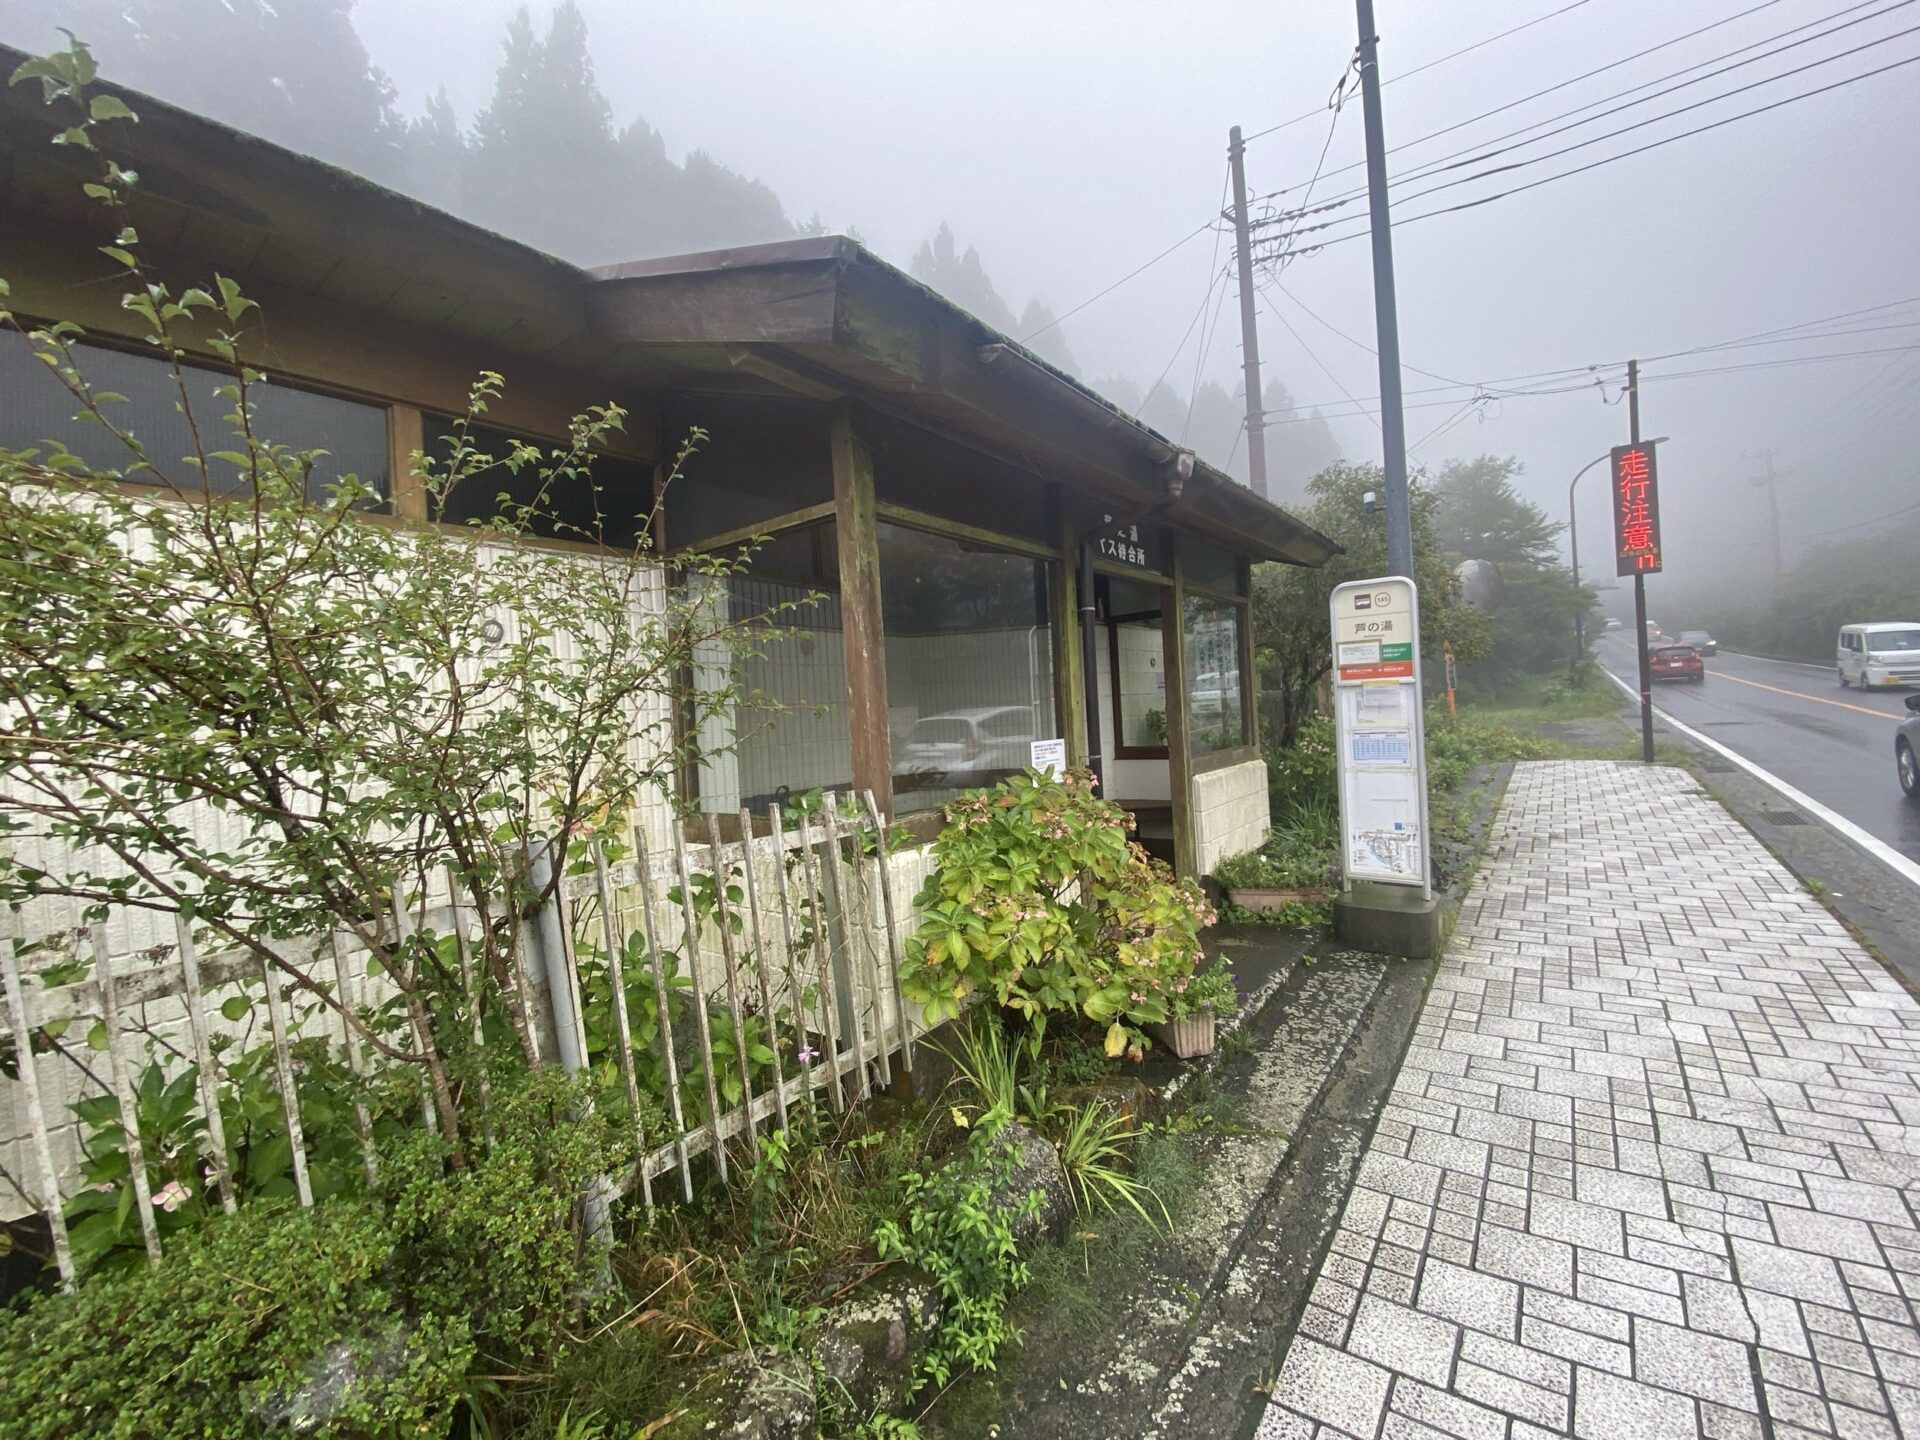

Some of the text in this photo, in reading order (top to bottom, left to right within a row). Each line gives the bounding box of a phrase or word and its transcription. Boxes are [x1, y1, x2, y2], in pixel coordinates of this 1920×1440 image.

[1619, 449, 1653, 551] 走行注意
[1638, 554, 1653, 569] 17
[1355, 620, 1393, 634] 芦の湯
